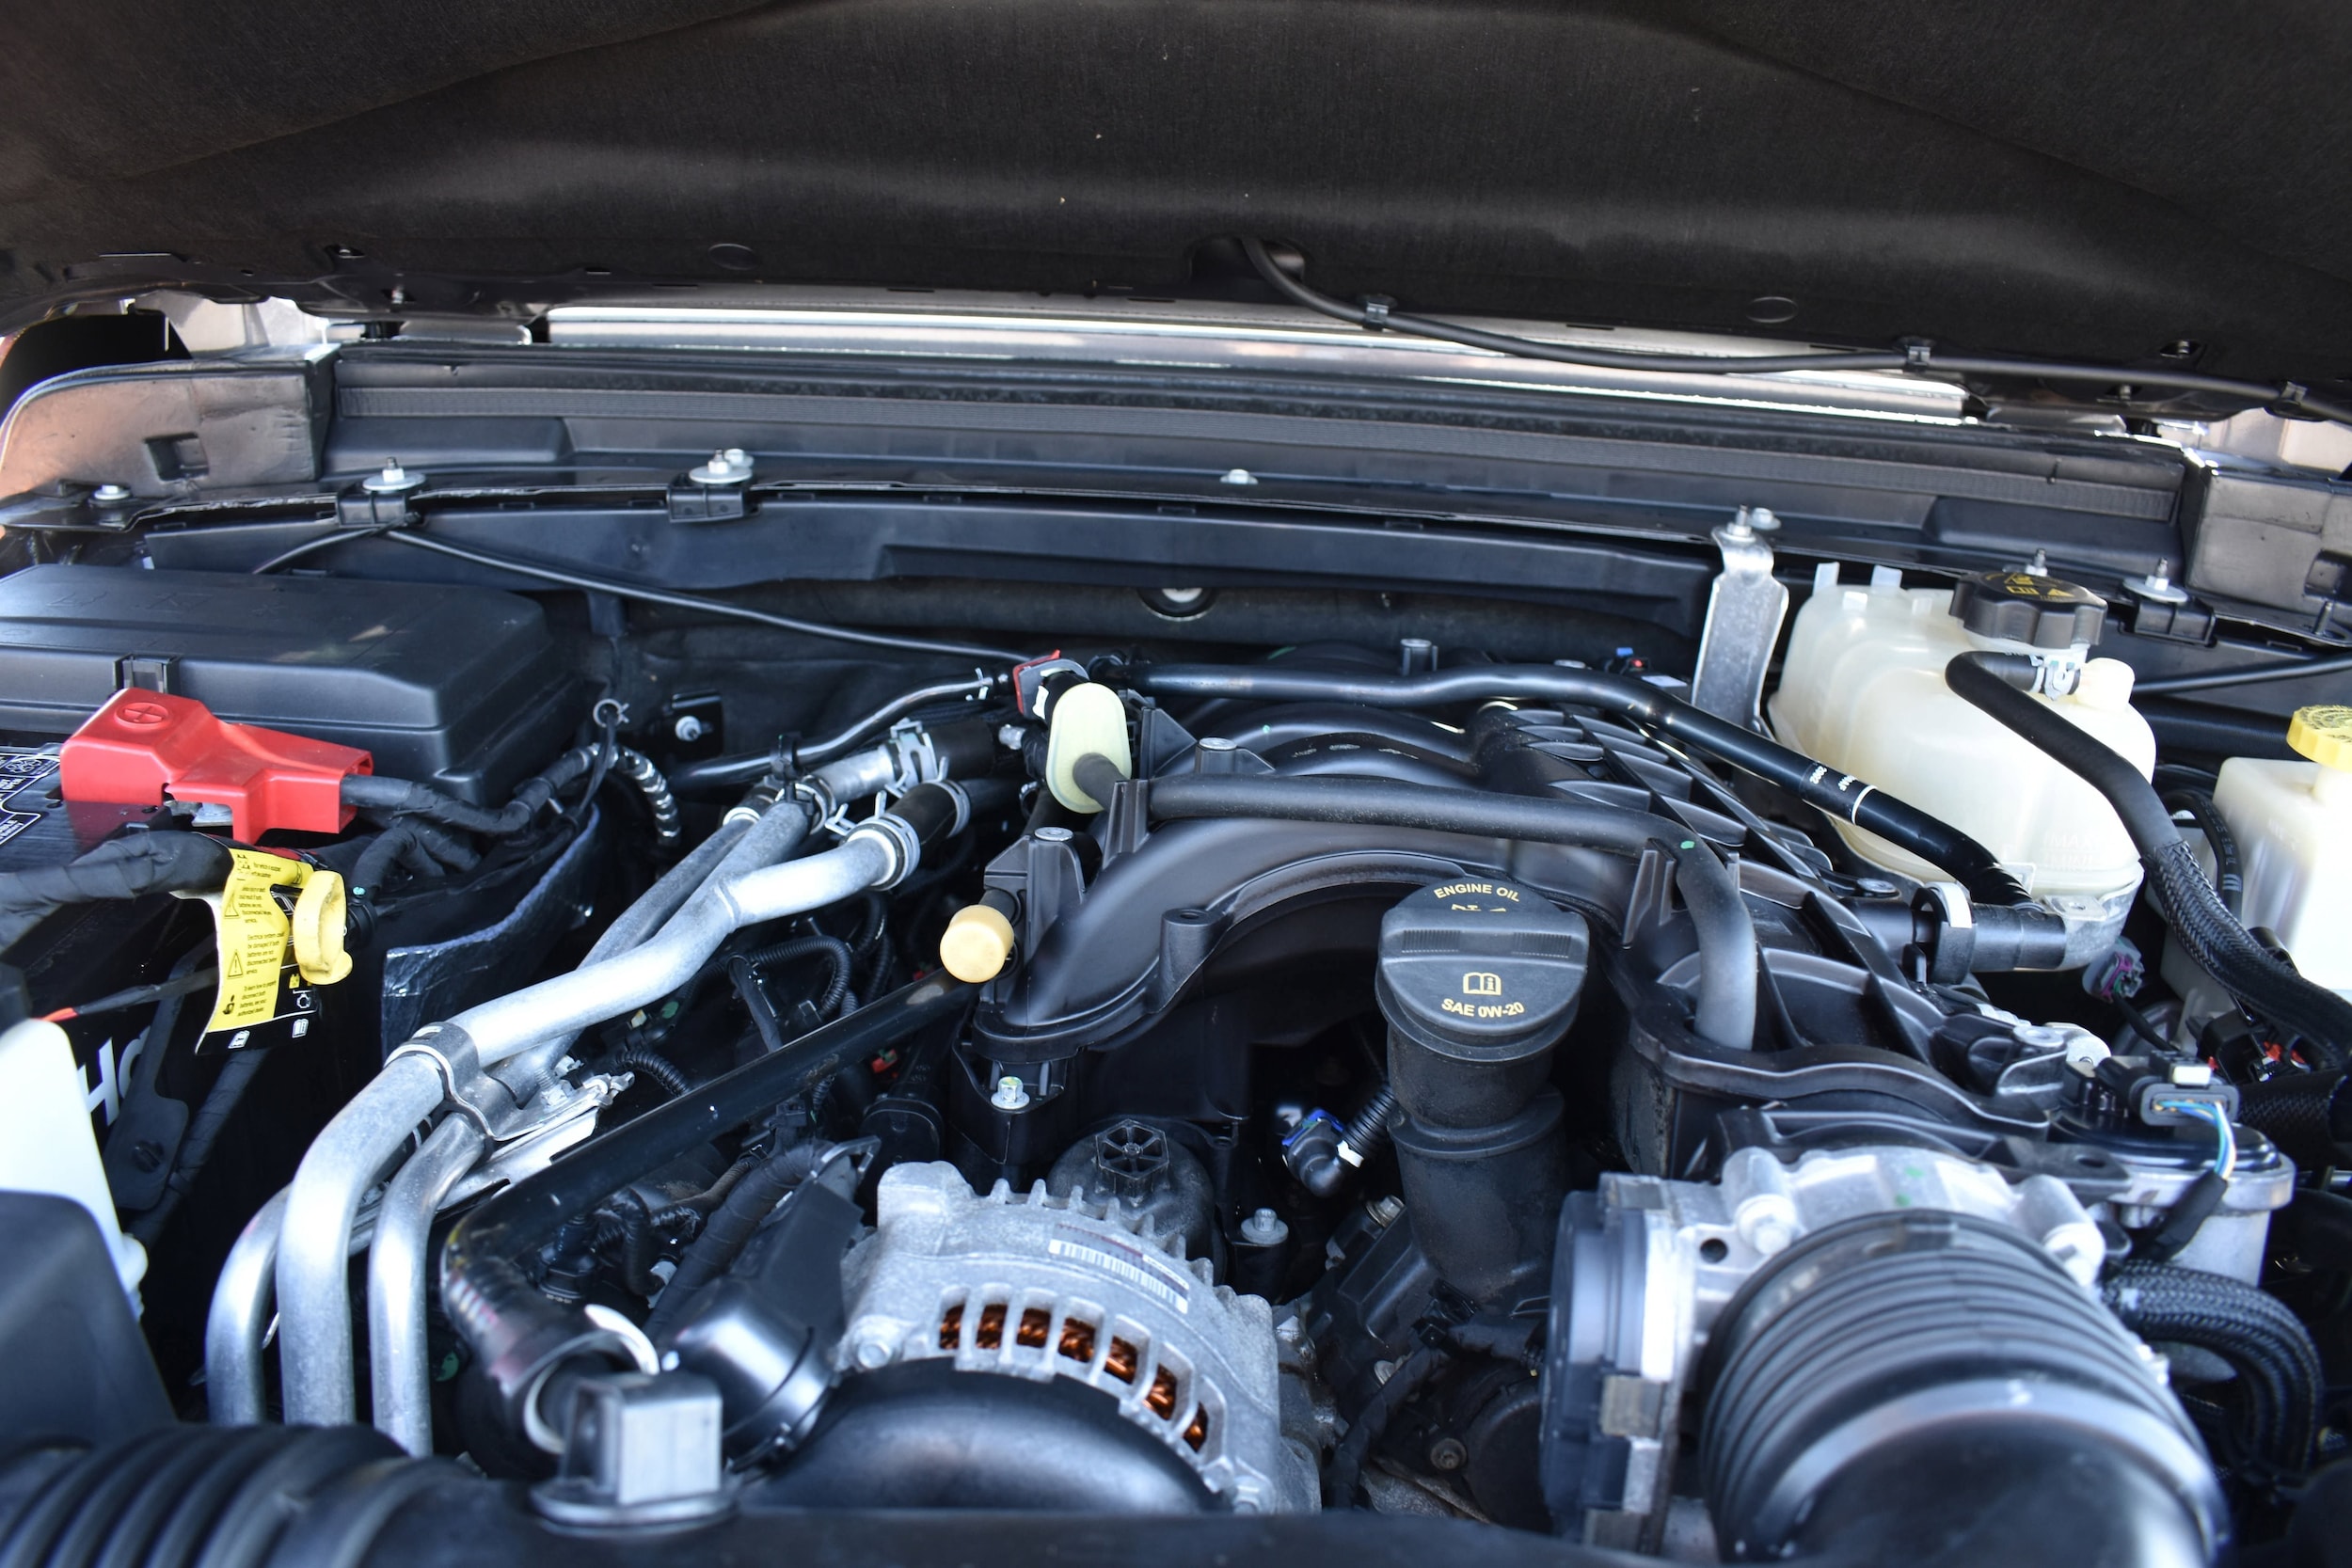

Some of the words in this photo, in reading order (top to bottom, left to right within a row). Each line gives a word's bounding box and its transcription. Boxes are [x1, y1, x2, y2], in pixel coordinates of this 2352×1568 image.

[1434, 883, 1492, 899] ENGINE
[1496, 887, 1520, 902] OIL
[1441, 998, 1475, 1017] SAE
[1478, 1001, 1525, 1018] 0W-20
